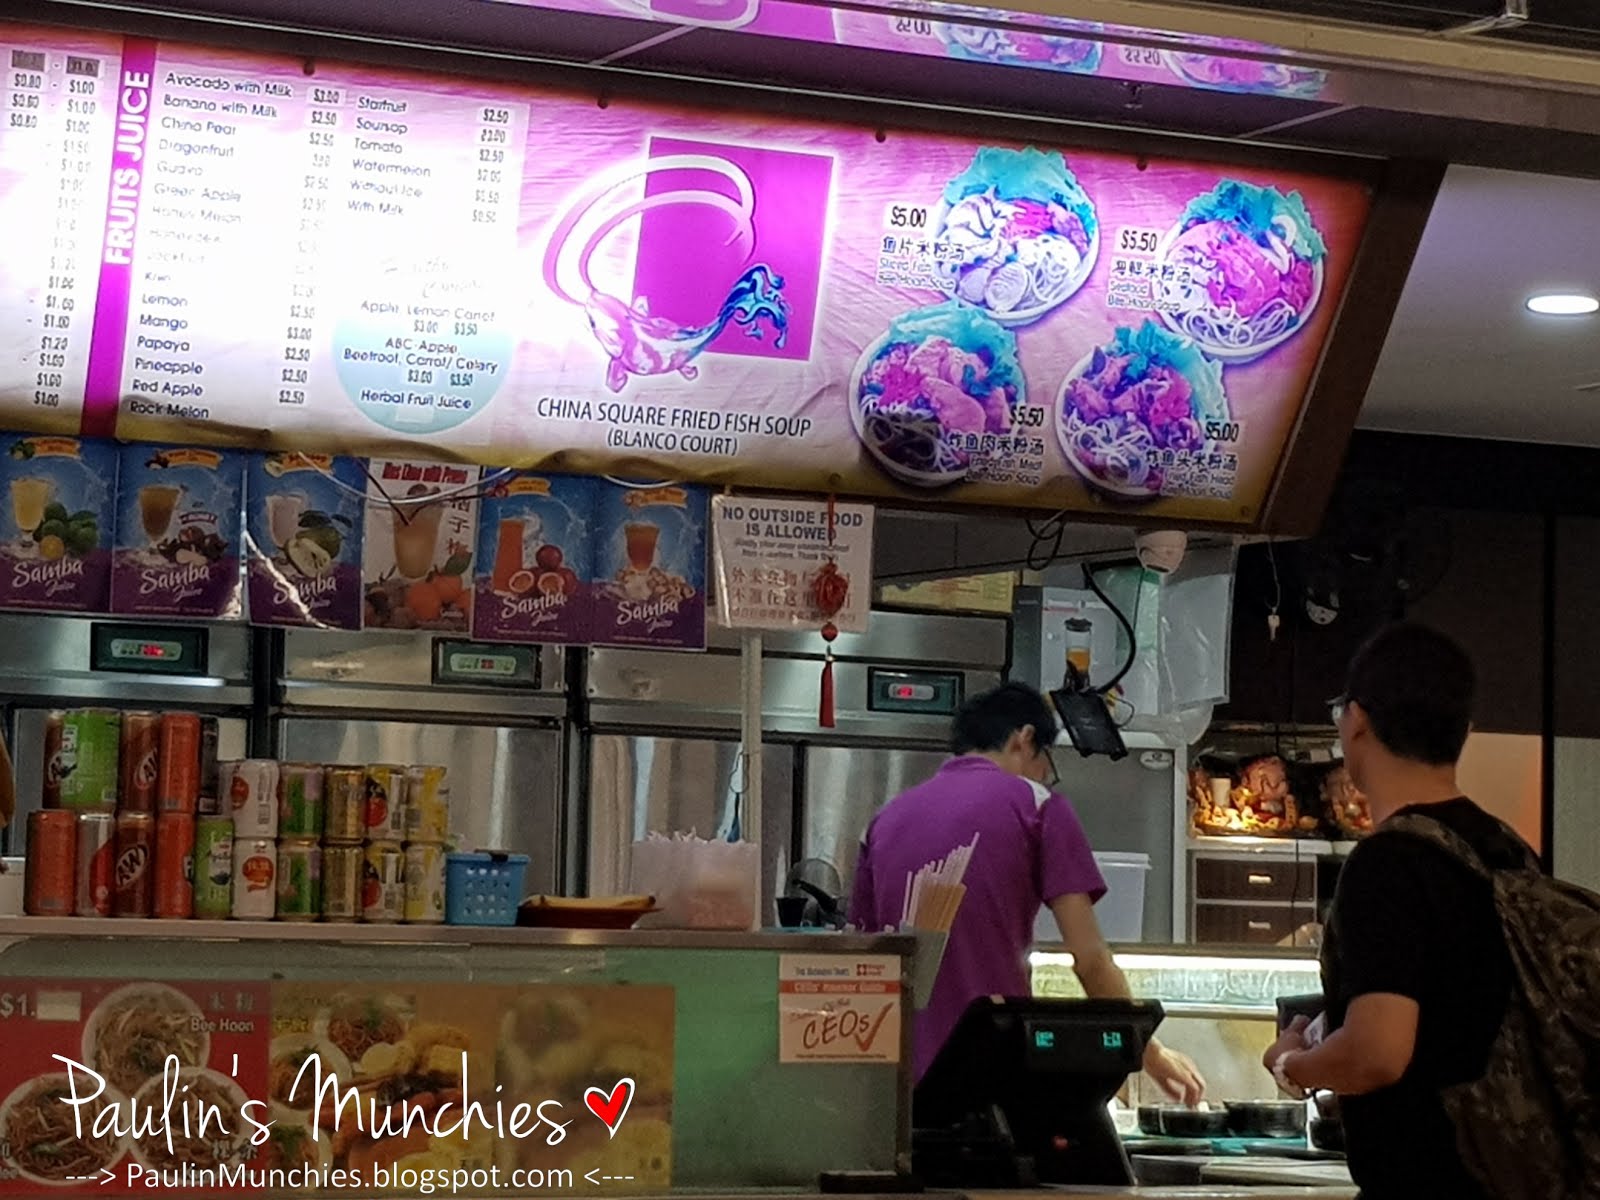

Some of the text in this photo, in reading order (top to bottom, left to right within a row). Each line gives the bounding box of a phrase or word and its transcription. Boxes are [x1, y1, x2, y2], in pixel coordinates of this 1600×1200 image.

[69, 79, 94, 95] $1.00
[165, 72, 230, 90] Avocado
[234, 80, 260, 95] with
[265, 83, 293, 98] Milk
[67, 98, 96, 114] $1.00
[163, 93, 216, 111] Banana
[222, 102, 247, 115] with
[251, 104, 278, 118] Milk
[483, 108, 509, 124] $2.50
[161, 116, 202, 131] China
[354, 137, 403, 154] Tomato
[105, 71, 149, 264] FRUITS JUICE
[890, 206, 927, 228] $5.00
[1120, 229, 1158, 252] $5.50
[142, 293, 188, 307] Lemon
[139, 314, 188, 332] Mango
[136, 335, 310, 362] Papaya $2.50
[134, 357, 307, 384] Pineapple $2.50
[132, 378, 159, 393] Red
[161, 381, 204, 397] Apple
[130, 400, 209, 419] Rock Melon
[361, 389, 472, 409] Herbal Fruit Juice
[537, 397, 811, 437] CHINA SQUARE FRIED FISH SOUP
[608, 428, 738, 456] (BLANCO COURT)
[1205, 421, 1239, 442] $5.00
[723, 507, 744, 520] NO
[749, 508, 815, 524] OUTSIDE
[746, 523, 760, 536] IS
[12, 560, 84, 588] Samba
[140, 566, 210, 594] Samba
[501, 592, 567, 619] Samba
[616, 597, 679, 625] Samba
[190, 1016, 255, 1032] Bee Hoon
